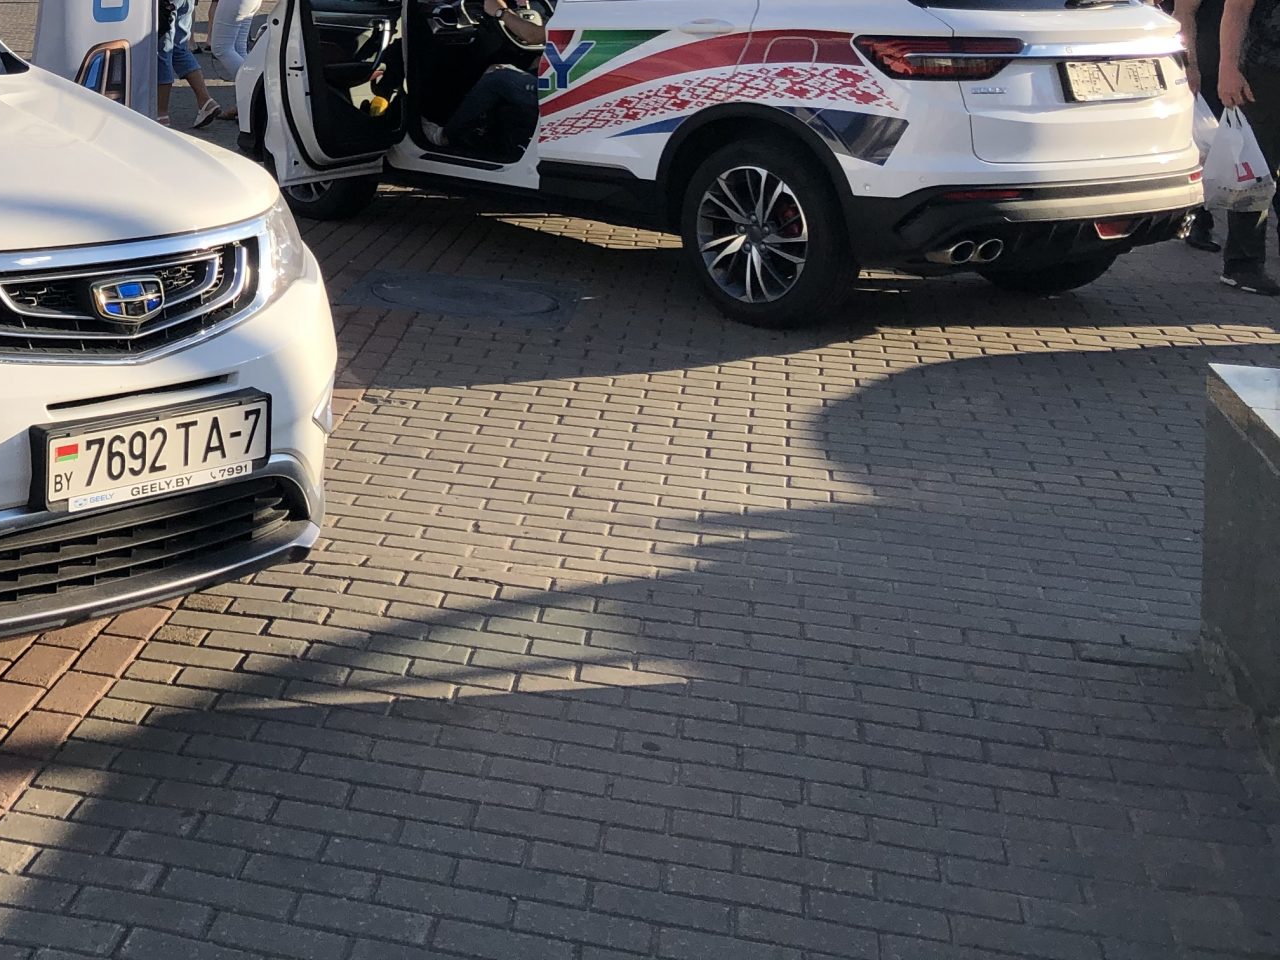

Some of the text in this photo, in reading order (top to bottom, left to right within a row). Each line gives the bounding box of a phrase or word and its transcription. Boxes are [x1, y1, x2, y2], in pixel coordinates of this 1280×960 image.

[85, 408, 261, 487] 7692 TA-7
[54, 471, 73, 493] BY
[130, 476, 192, 497] GEELY.BY
[219, 464, 248, 478] 7991
